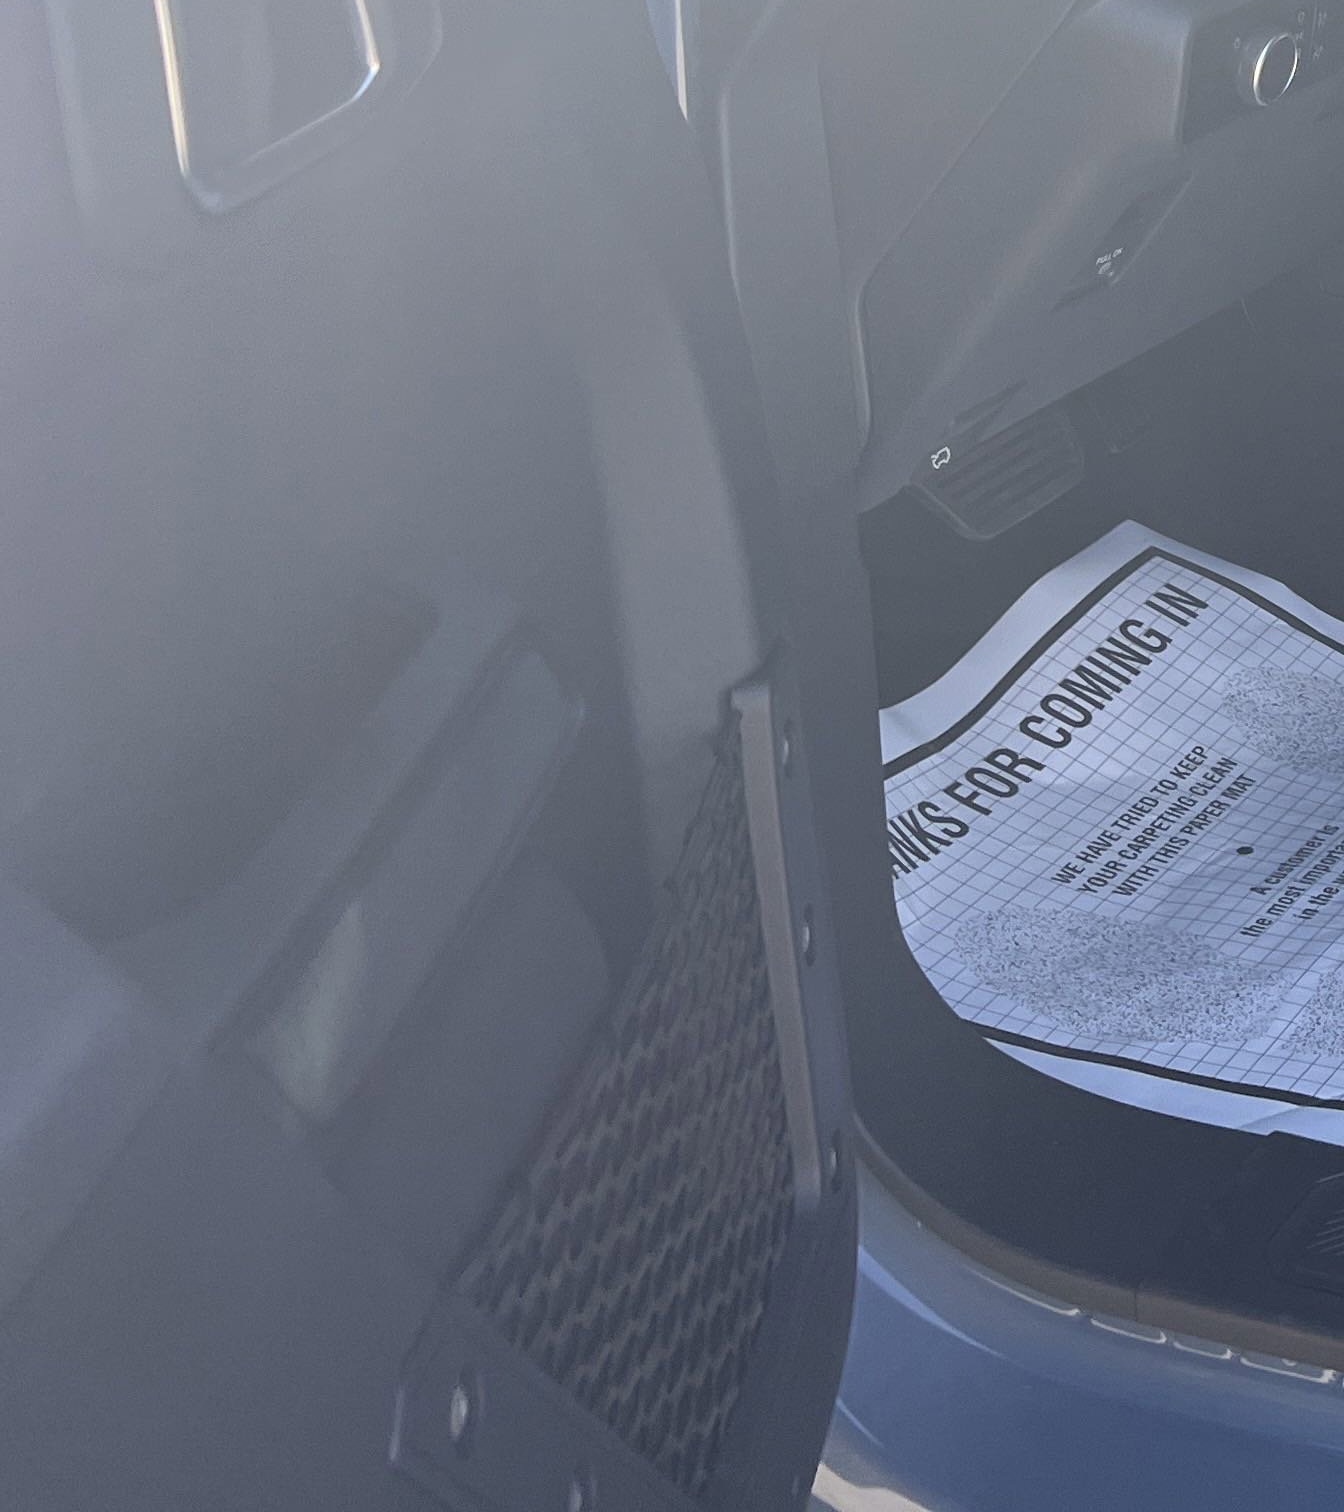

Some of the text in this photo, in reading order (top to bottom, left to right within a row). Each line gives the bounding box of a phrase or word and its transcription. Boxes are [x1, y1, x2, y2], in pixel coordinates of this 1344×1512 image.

[943, 748, 1046, 816] FOR
[1019, 619, 1173, 749] COMING
[1145, 583, 1209, 627] IN
[1054, 745, 1209, 886] WE HAVE TRIED TO KEEP
[1077, 757, 1238, 895] YOUR CARPETING CLEAN
[1111, 773, 1257, 898] WITH THIS PAPER MAT
[1250, 823, 1340, 896] A customer is
[1240, 916, 1273, 939] the
[1267, 885, 1306, 920] most
[1293, 903, 1319, 922] in
[1313, 882, 1341, 908] the
